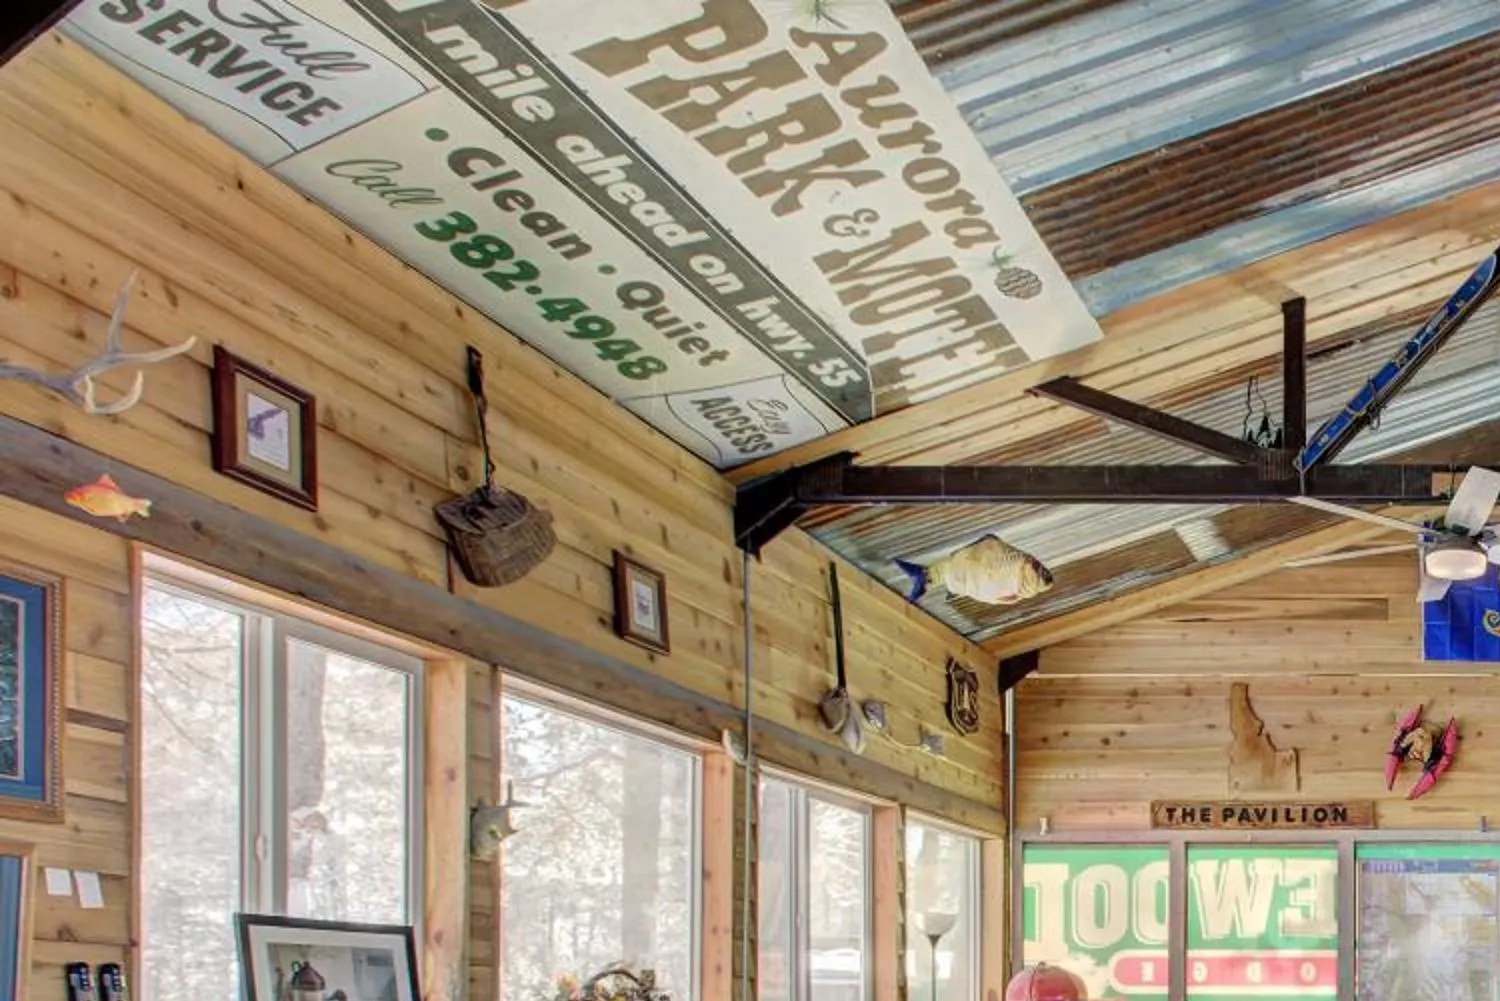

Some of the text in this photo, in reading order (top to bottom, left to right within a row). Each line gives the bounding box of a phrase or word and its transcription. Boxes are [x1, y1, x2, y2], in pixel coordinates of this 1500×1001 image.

[99, 0, 344, 127] SERVICE
[570, 0, 887, 218] PARK
[822, 207, 881, 238] &
[788, 26, 1002, 250] Aurora
[325, 158, 445, 209] Call
[424, 22, 864, 388] mile ahead on hwy. 55
[446, 146, 731, 368] Clean Quiet
[690, 396, 774, 454] ACCESS
[1165, 807, 1349, 823] THE PAVILION
